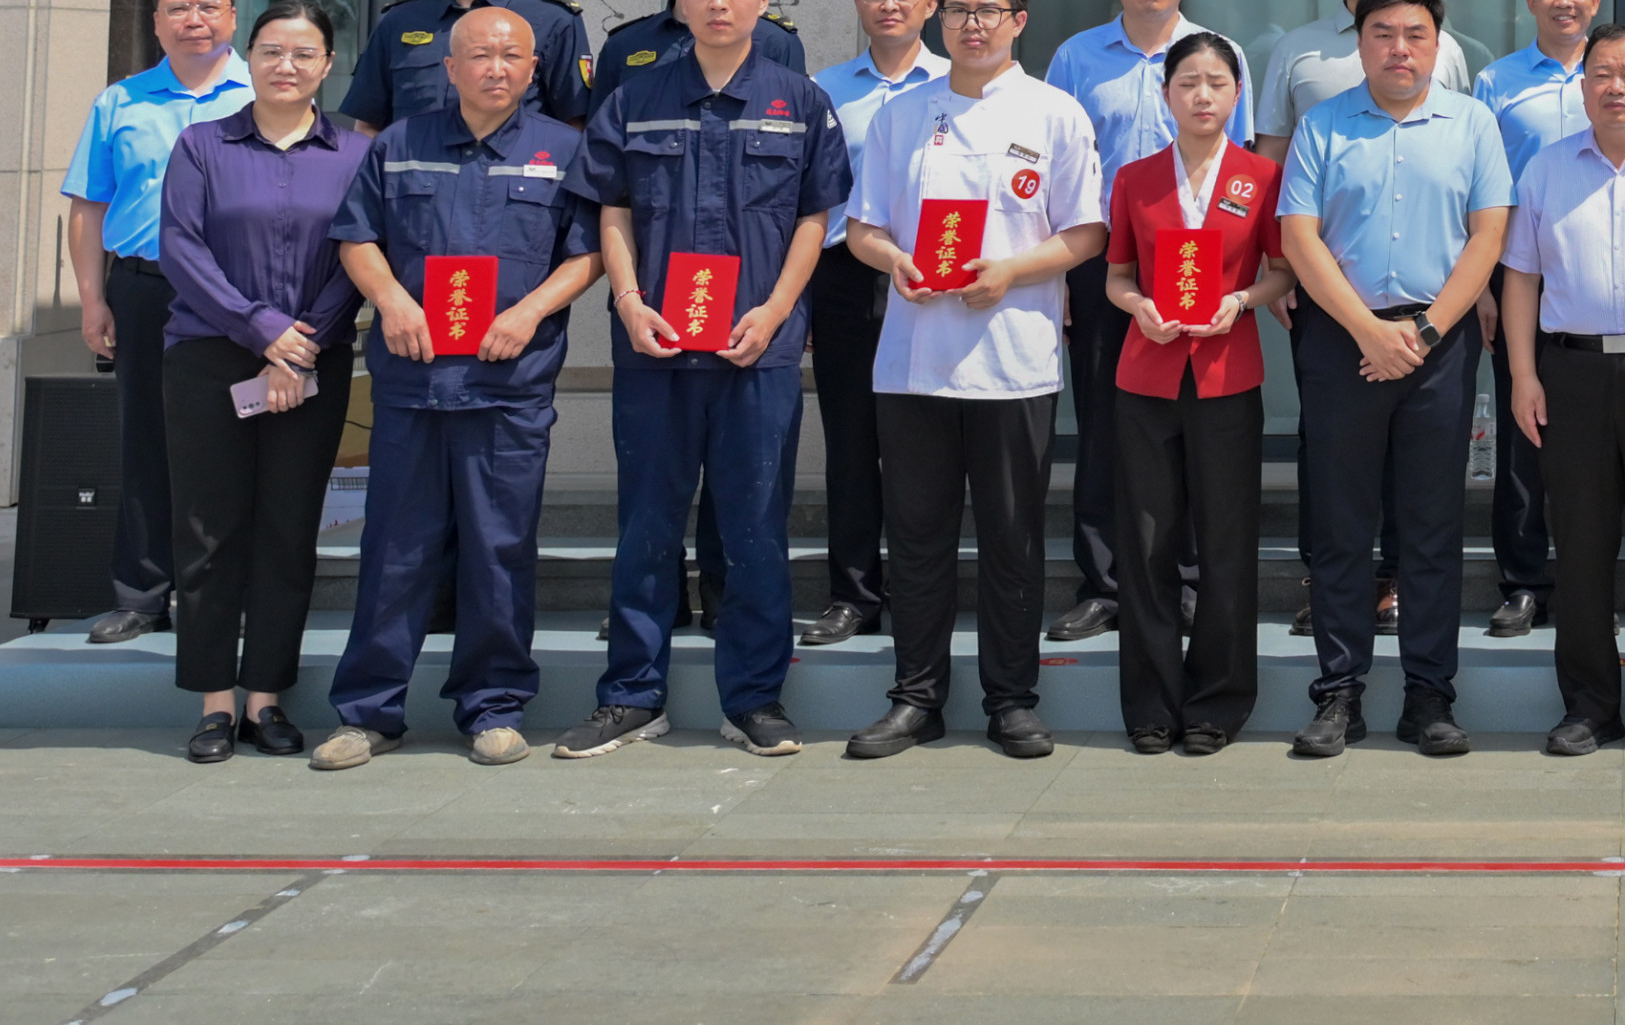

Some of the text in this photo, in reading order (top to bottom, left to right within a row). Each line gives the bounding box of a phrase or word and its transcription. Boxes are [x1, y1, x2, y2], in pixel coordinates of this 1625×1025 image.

[1018, 175, 1037, 195] 19
[1230, 179, 1254, 198] 02
[935, 211, 962, 278] 荣誉证书
[1175, 239, 1202, 311] 荣誉证书
[445, 269, 472, 341] 荣誉证书
[685, 267, 713, 337] 荣誉证书
